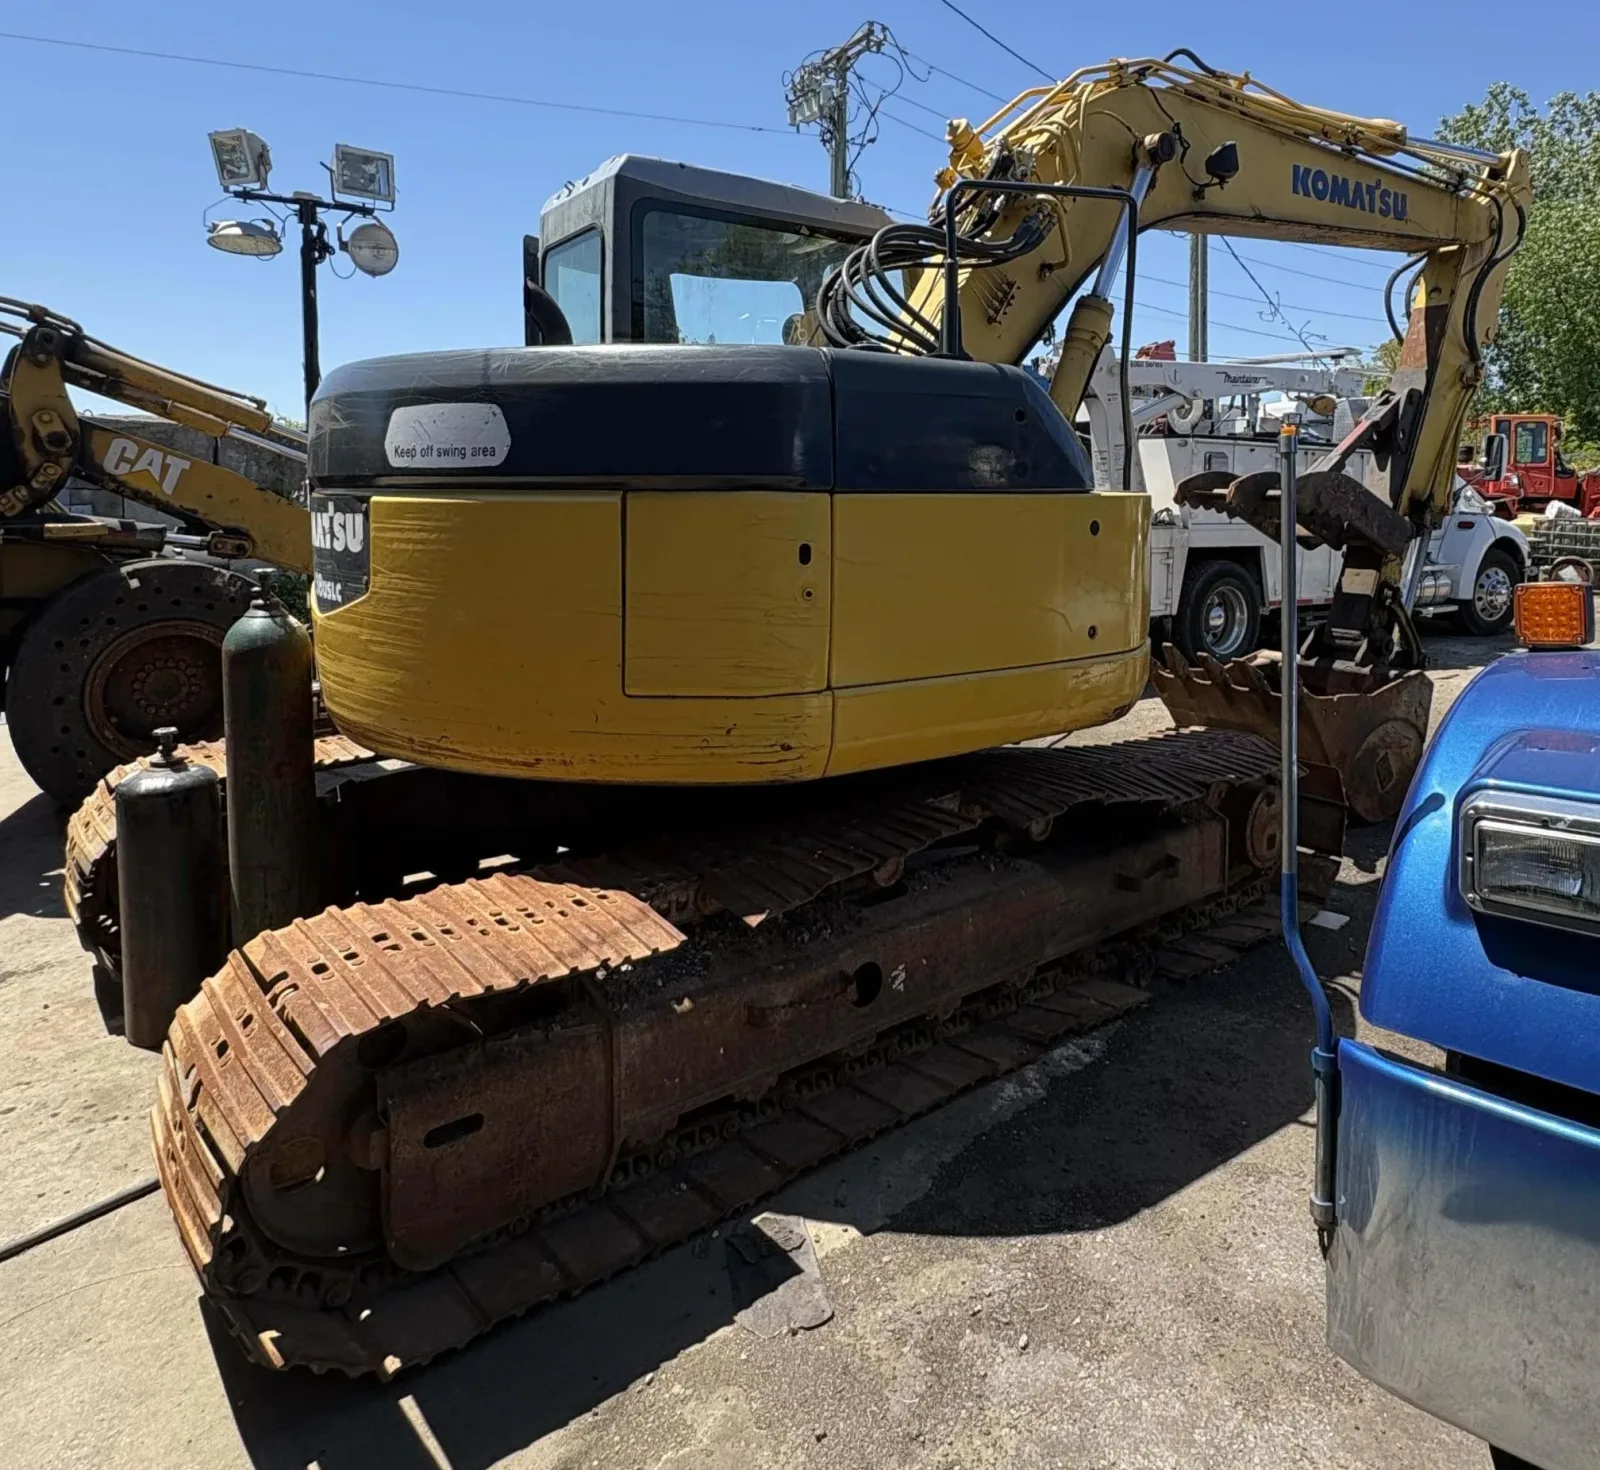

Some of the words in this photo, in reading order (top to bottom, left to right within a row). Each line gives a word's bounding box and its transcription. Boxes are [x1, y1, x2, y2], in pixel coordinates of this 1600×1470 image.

[1292, 163, 1408, 222] KOMATSU
[102, 438, 191, 496] CAT
[394, 445, 417, 460] Keep
[420, 444, 434, 458] off
[436, 444, 467, 460] swing
[470, 446, 496, 457] area
